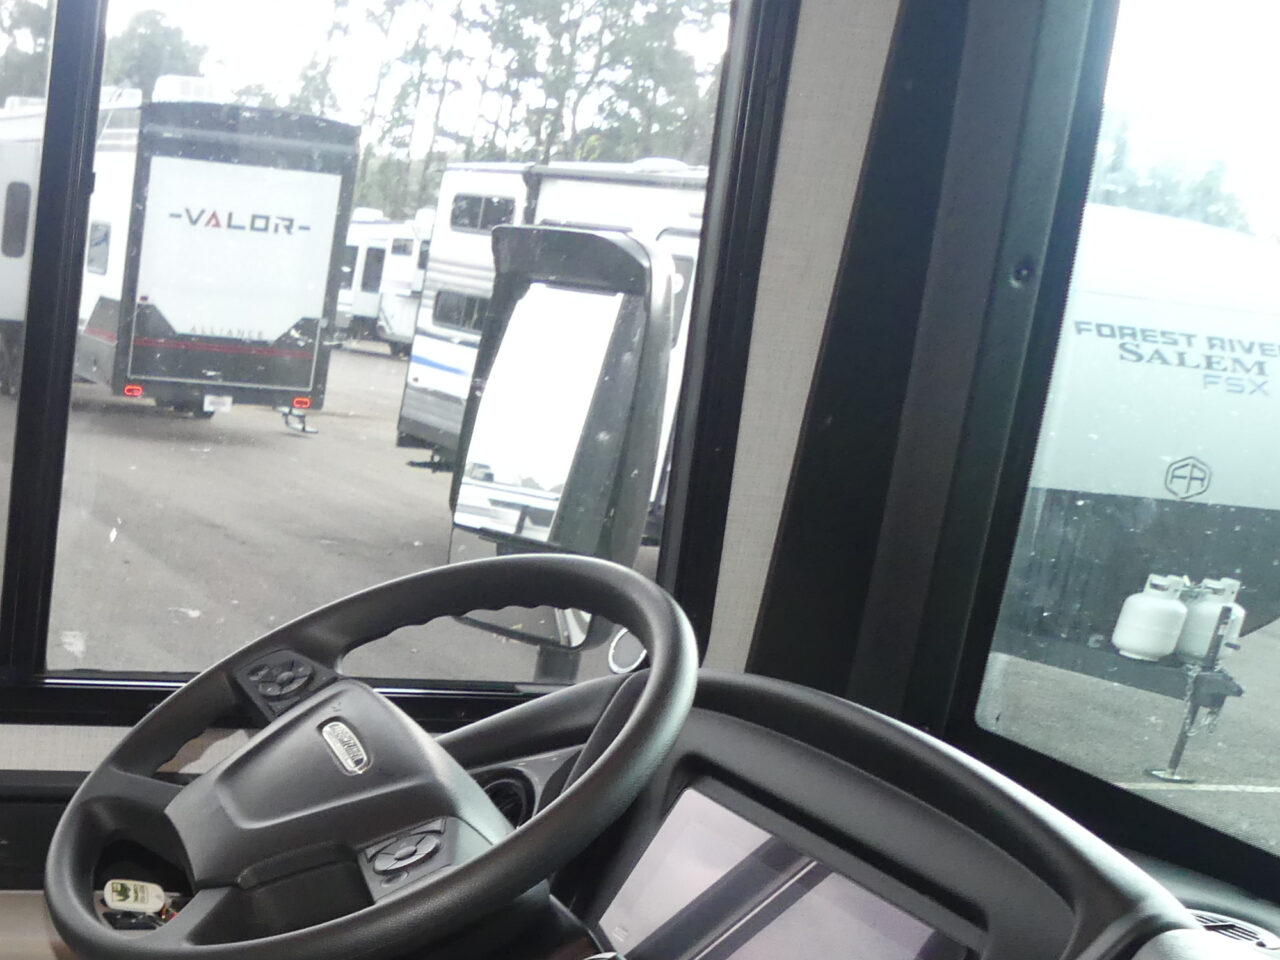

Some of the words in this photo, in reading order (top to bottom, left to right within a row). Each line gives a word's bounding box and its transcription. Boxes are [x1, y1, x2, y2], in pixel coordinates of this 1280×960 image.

[1074, 320, 1198, 349] FOREST
[1206, 335, 1280, 358] RIVE
[1118, 342, 1269, 377] SALEM
[1202, 373, 1270, 397] FSX
